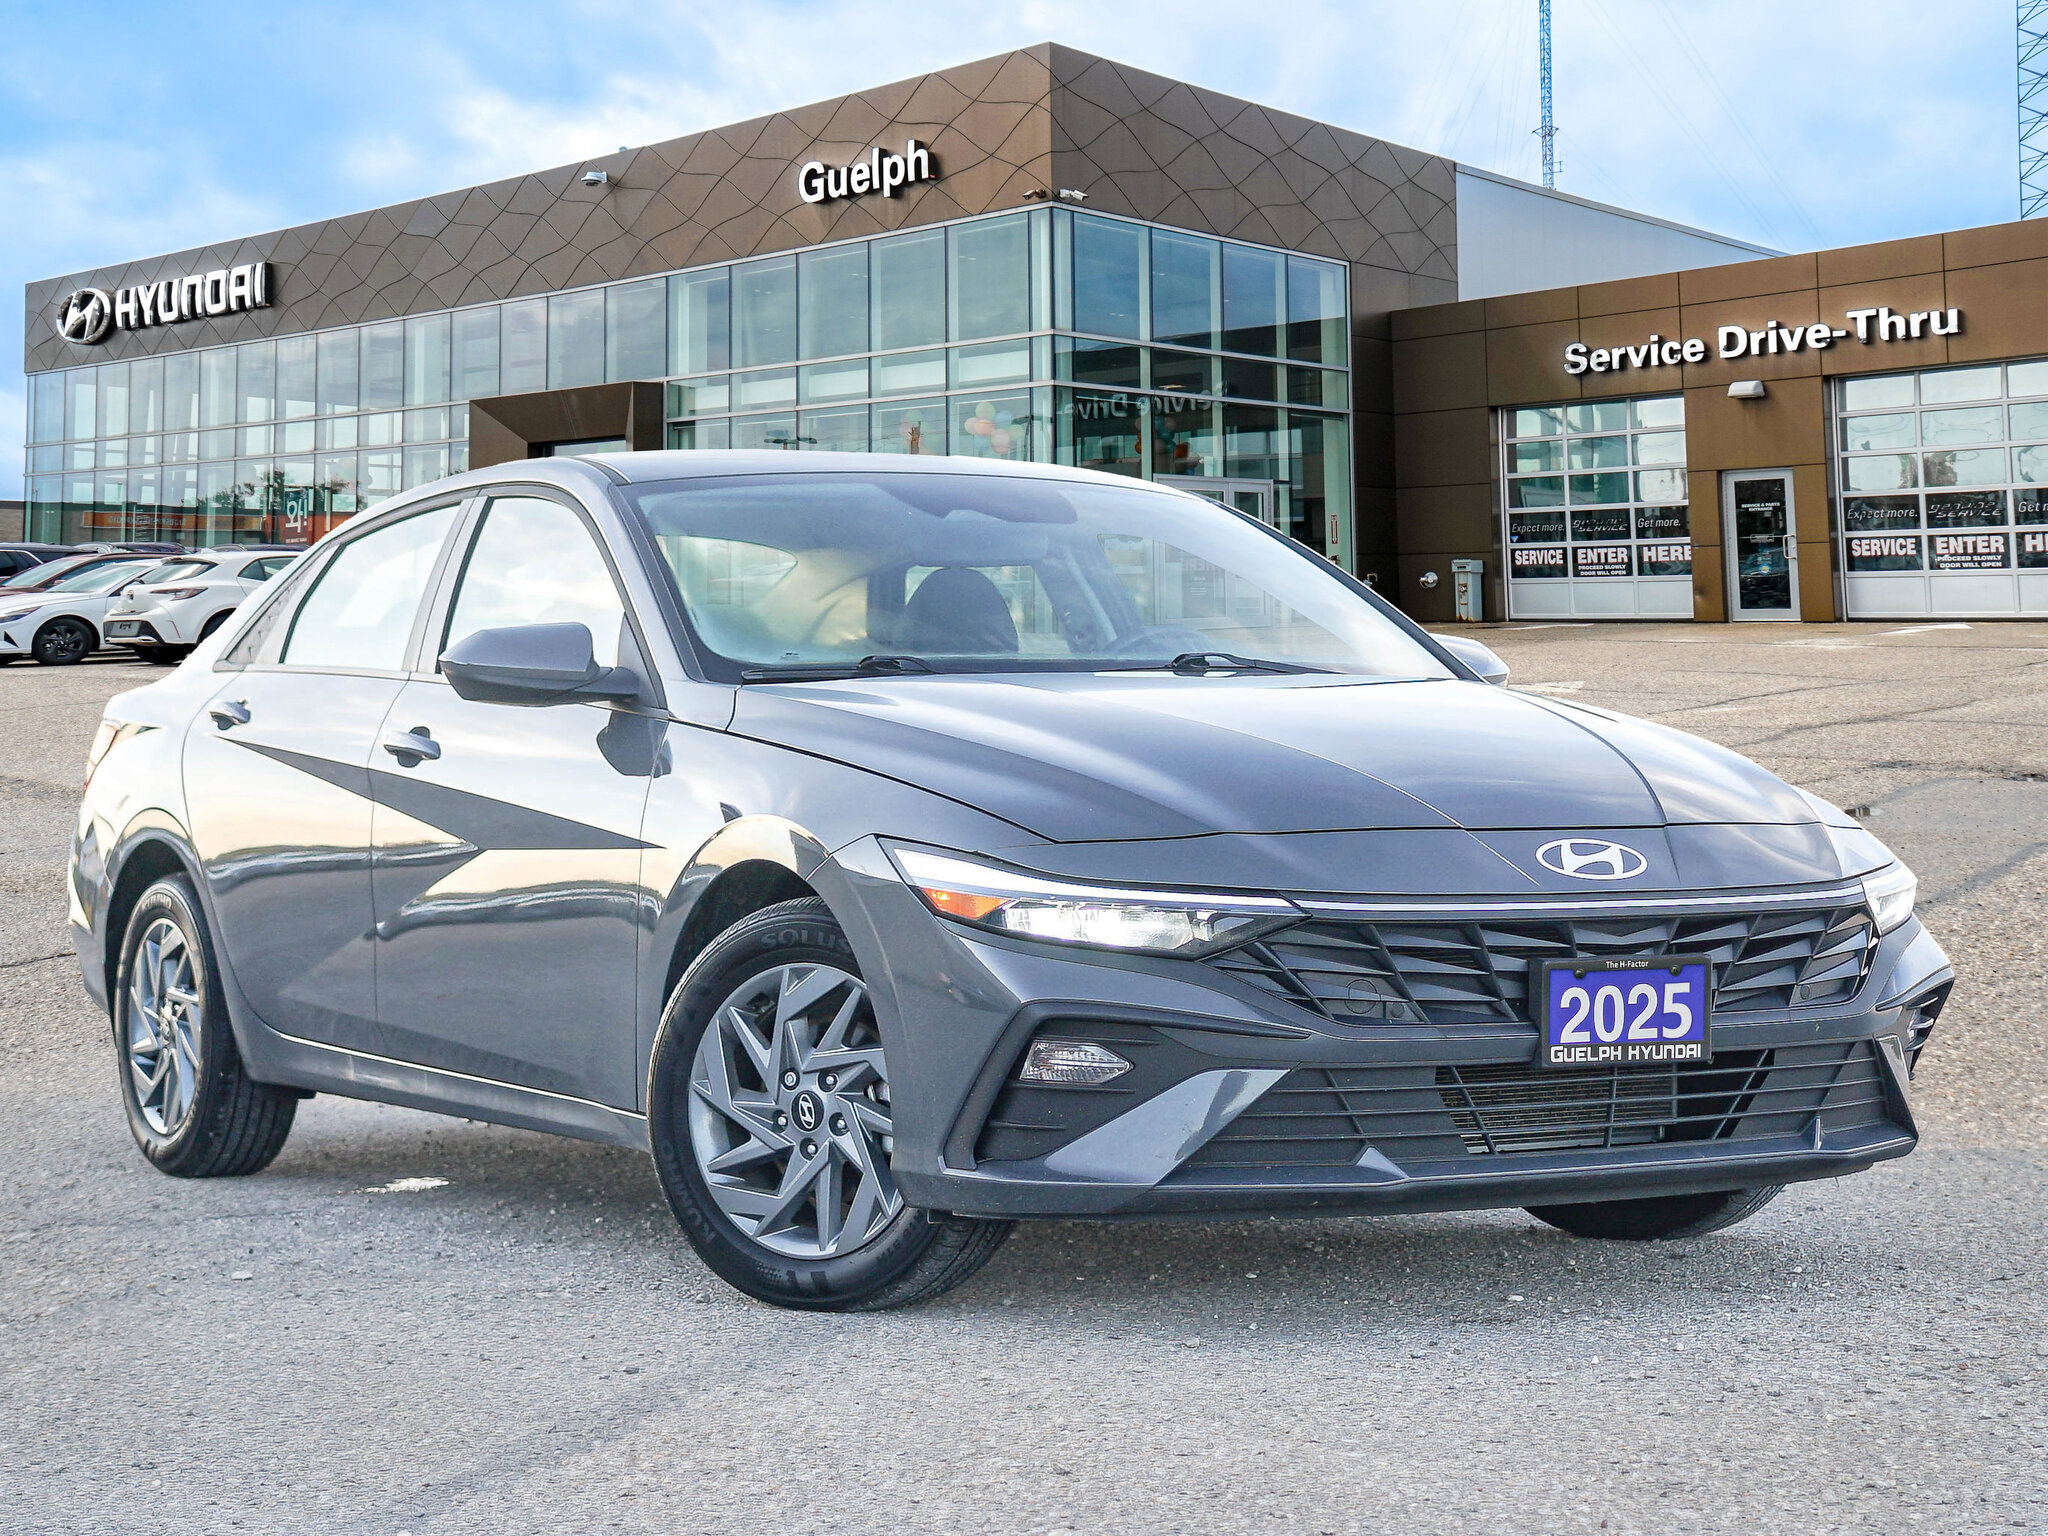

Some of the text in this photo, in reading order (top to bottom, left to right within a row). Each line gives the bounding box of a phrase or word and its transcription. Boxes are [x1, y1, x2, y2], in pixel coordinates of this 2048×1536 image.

[798, 138, 930, 204] Guelph
[115, 262, 268, 330] HYUNDAI
[1563, 306, 1961, 375] Service Drive-Thru
[1847, 508, 1918, 521] Expect more.
[2018, 501, 2041, 513] Get
[1512, 523, 1565, 534] Expect more.
[1637, 517, 1681, 528] Get more.
[1643, 545, 1692, 562] HERE
[1851, 538, 1917, 557] SERVICE
[1935, 535, 2006, 555] ENTER
[1514, 549, 1564, 565] SERVICE
[1577, 547, 1629, 564] ENTER
[1606, 960, 1649, 969] The H-Factor
[1560, 982, 1693, 1044] 2025
[1550, 1043, 1702, 1063] GUELPH HYUNDAI
